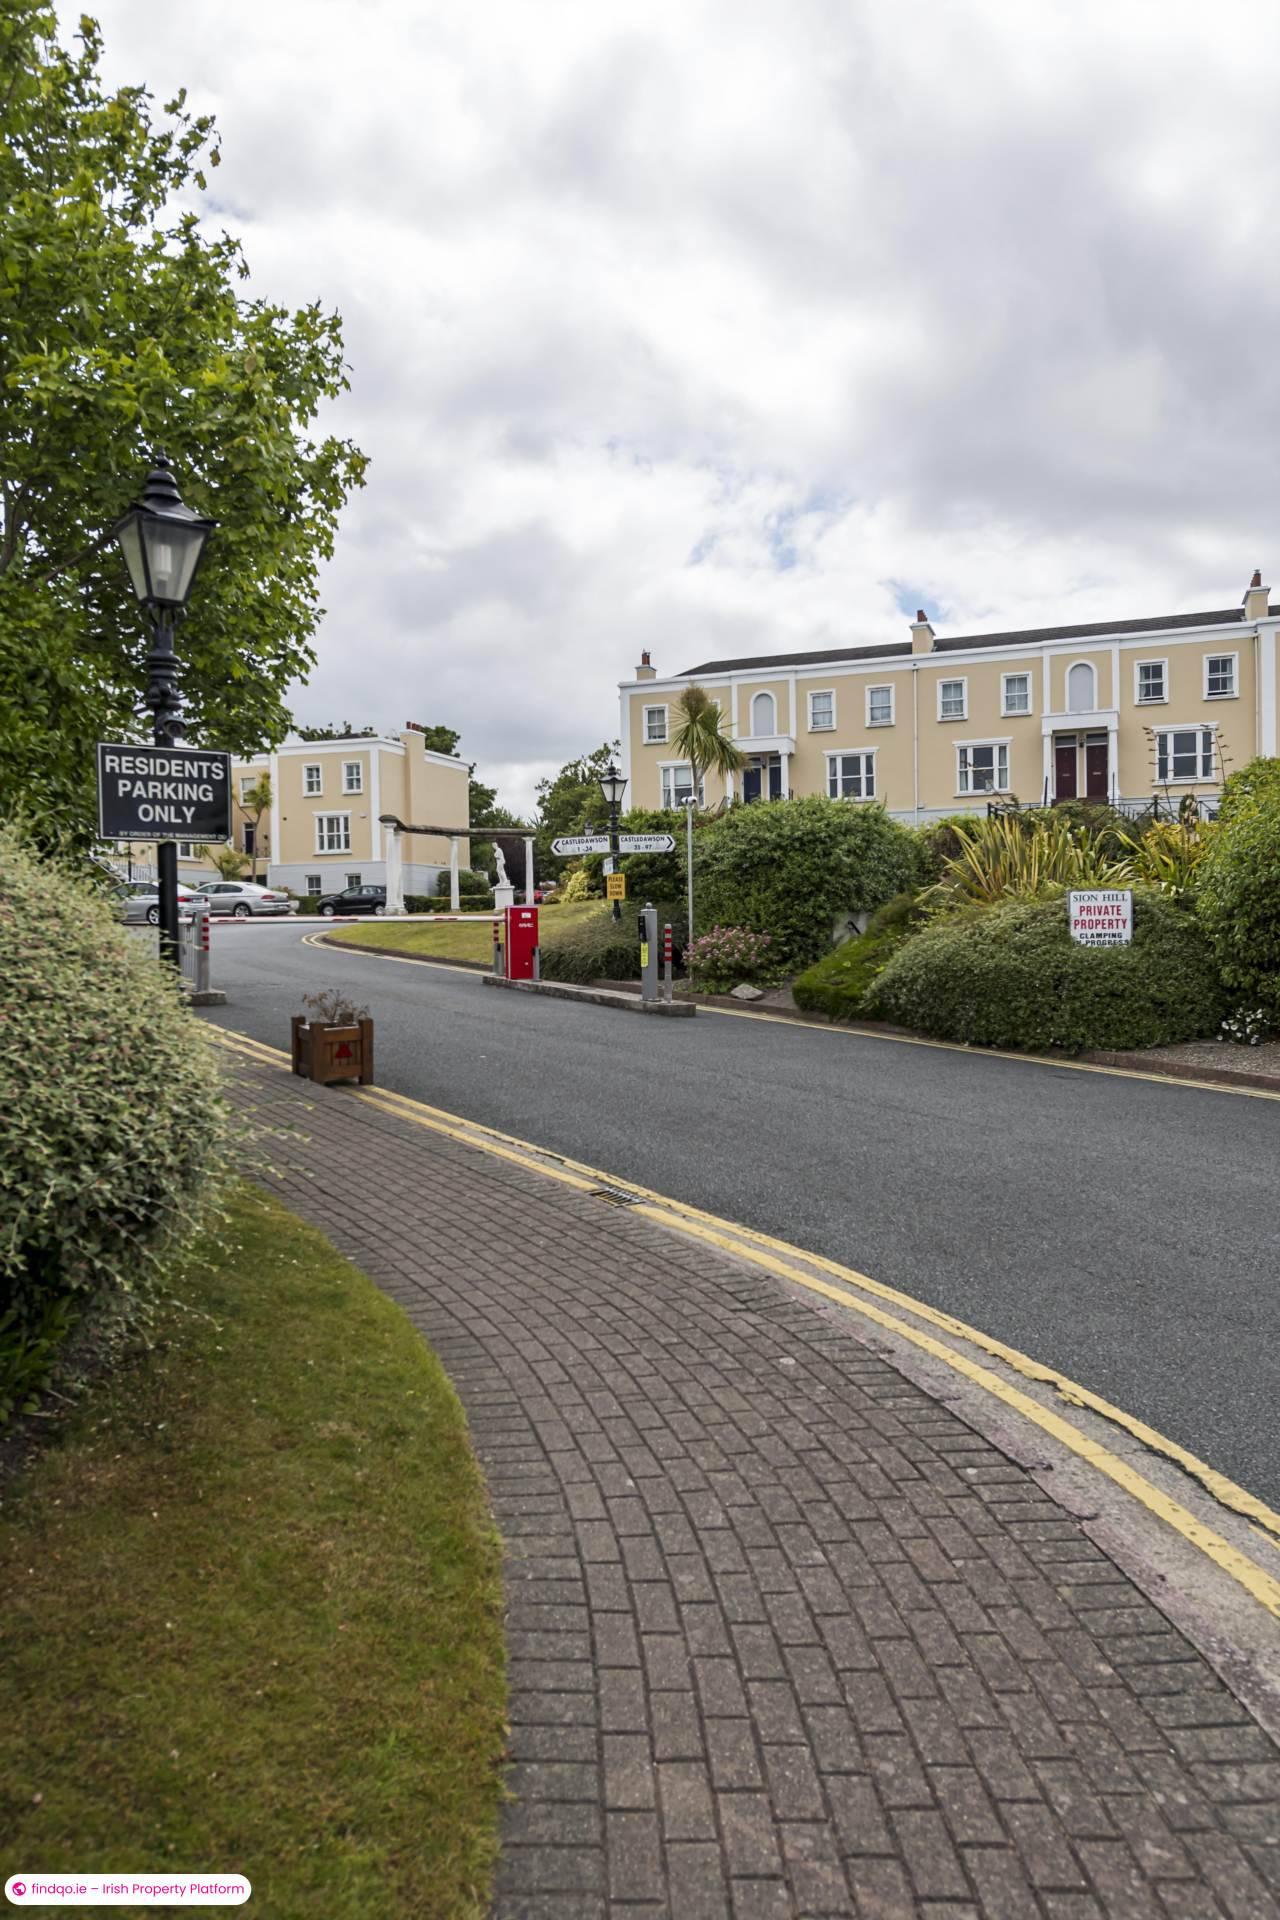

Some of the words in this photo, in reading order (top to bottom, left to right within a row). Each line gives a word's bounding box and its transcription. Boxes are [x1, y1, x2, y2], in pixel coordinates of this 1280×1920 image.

[105, 755, 225, 780] RESIDENTS
[118, 779, 214, 802] PARKING
[138, 804, 196, 824] ONLY
[561, 837, 608, 845] CASTLEDAWSON
[1073, 894, 1098, 902] SION
[1102, 894, 1128, 902] HILL
[1079, 905, 1122, 916] PRIVATE
[1073, 919, 1127, 930] PROPERTY
